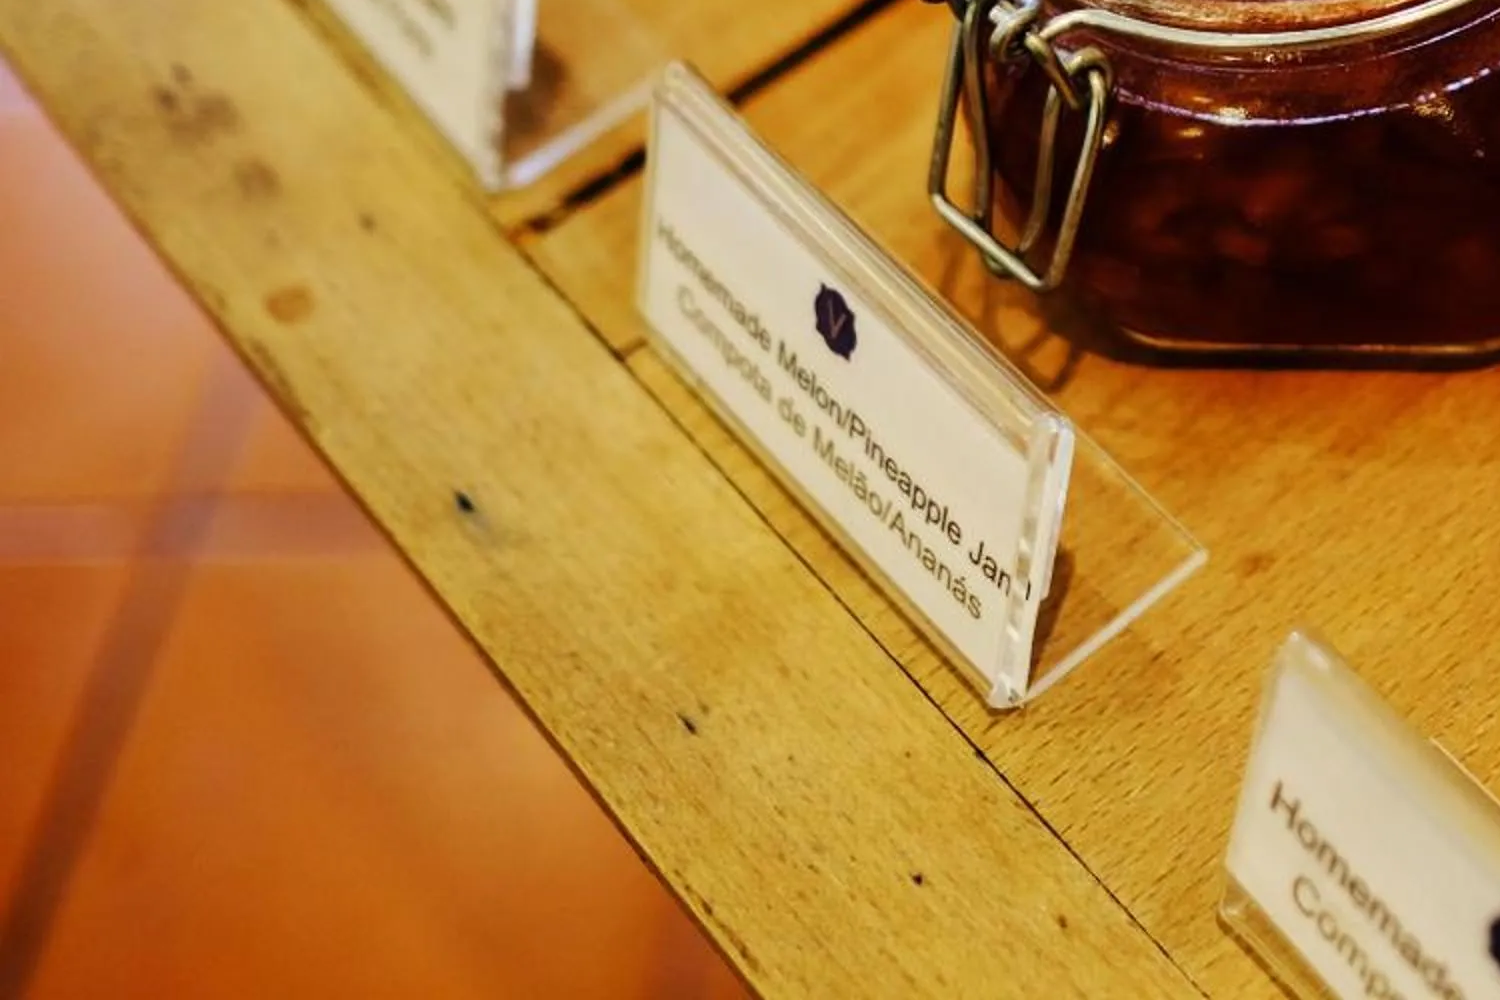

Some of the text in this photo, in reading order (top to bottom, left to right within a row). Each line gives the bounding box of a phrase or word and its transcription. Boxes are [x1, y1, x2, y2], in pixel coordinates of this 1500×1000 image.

[656, 218, 772, 351] Homemade
[777, 340, 962, 546] Melon/Pineapple
[777, 396, 807, 438] de
[813, 426, 982, 620] Melão/Ananás
